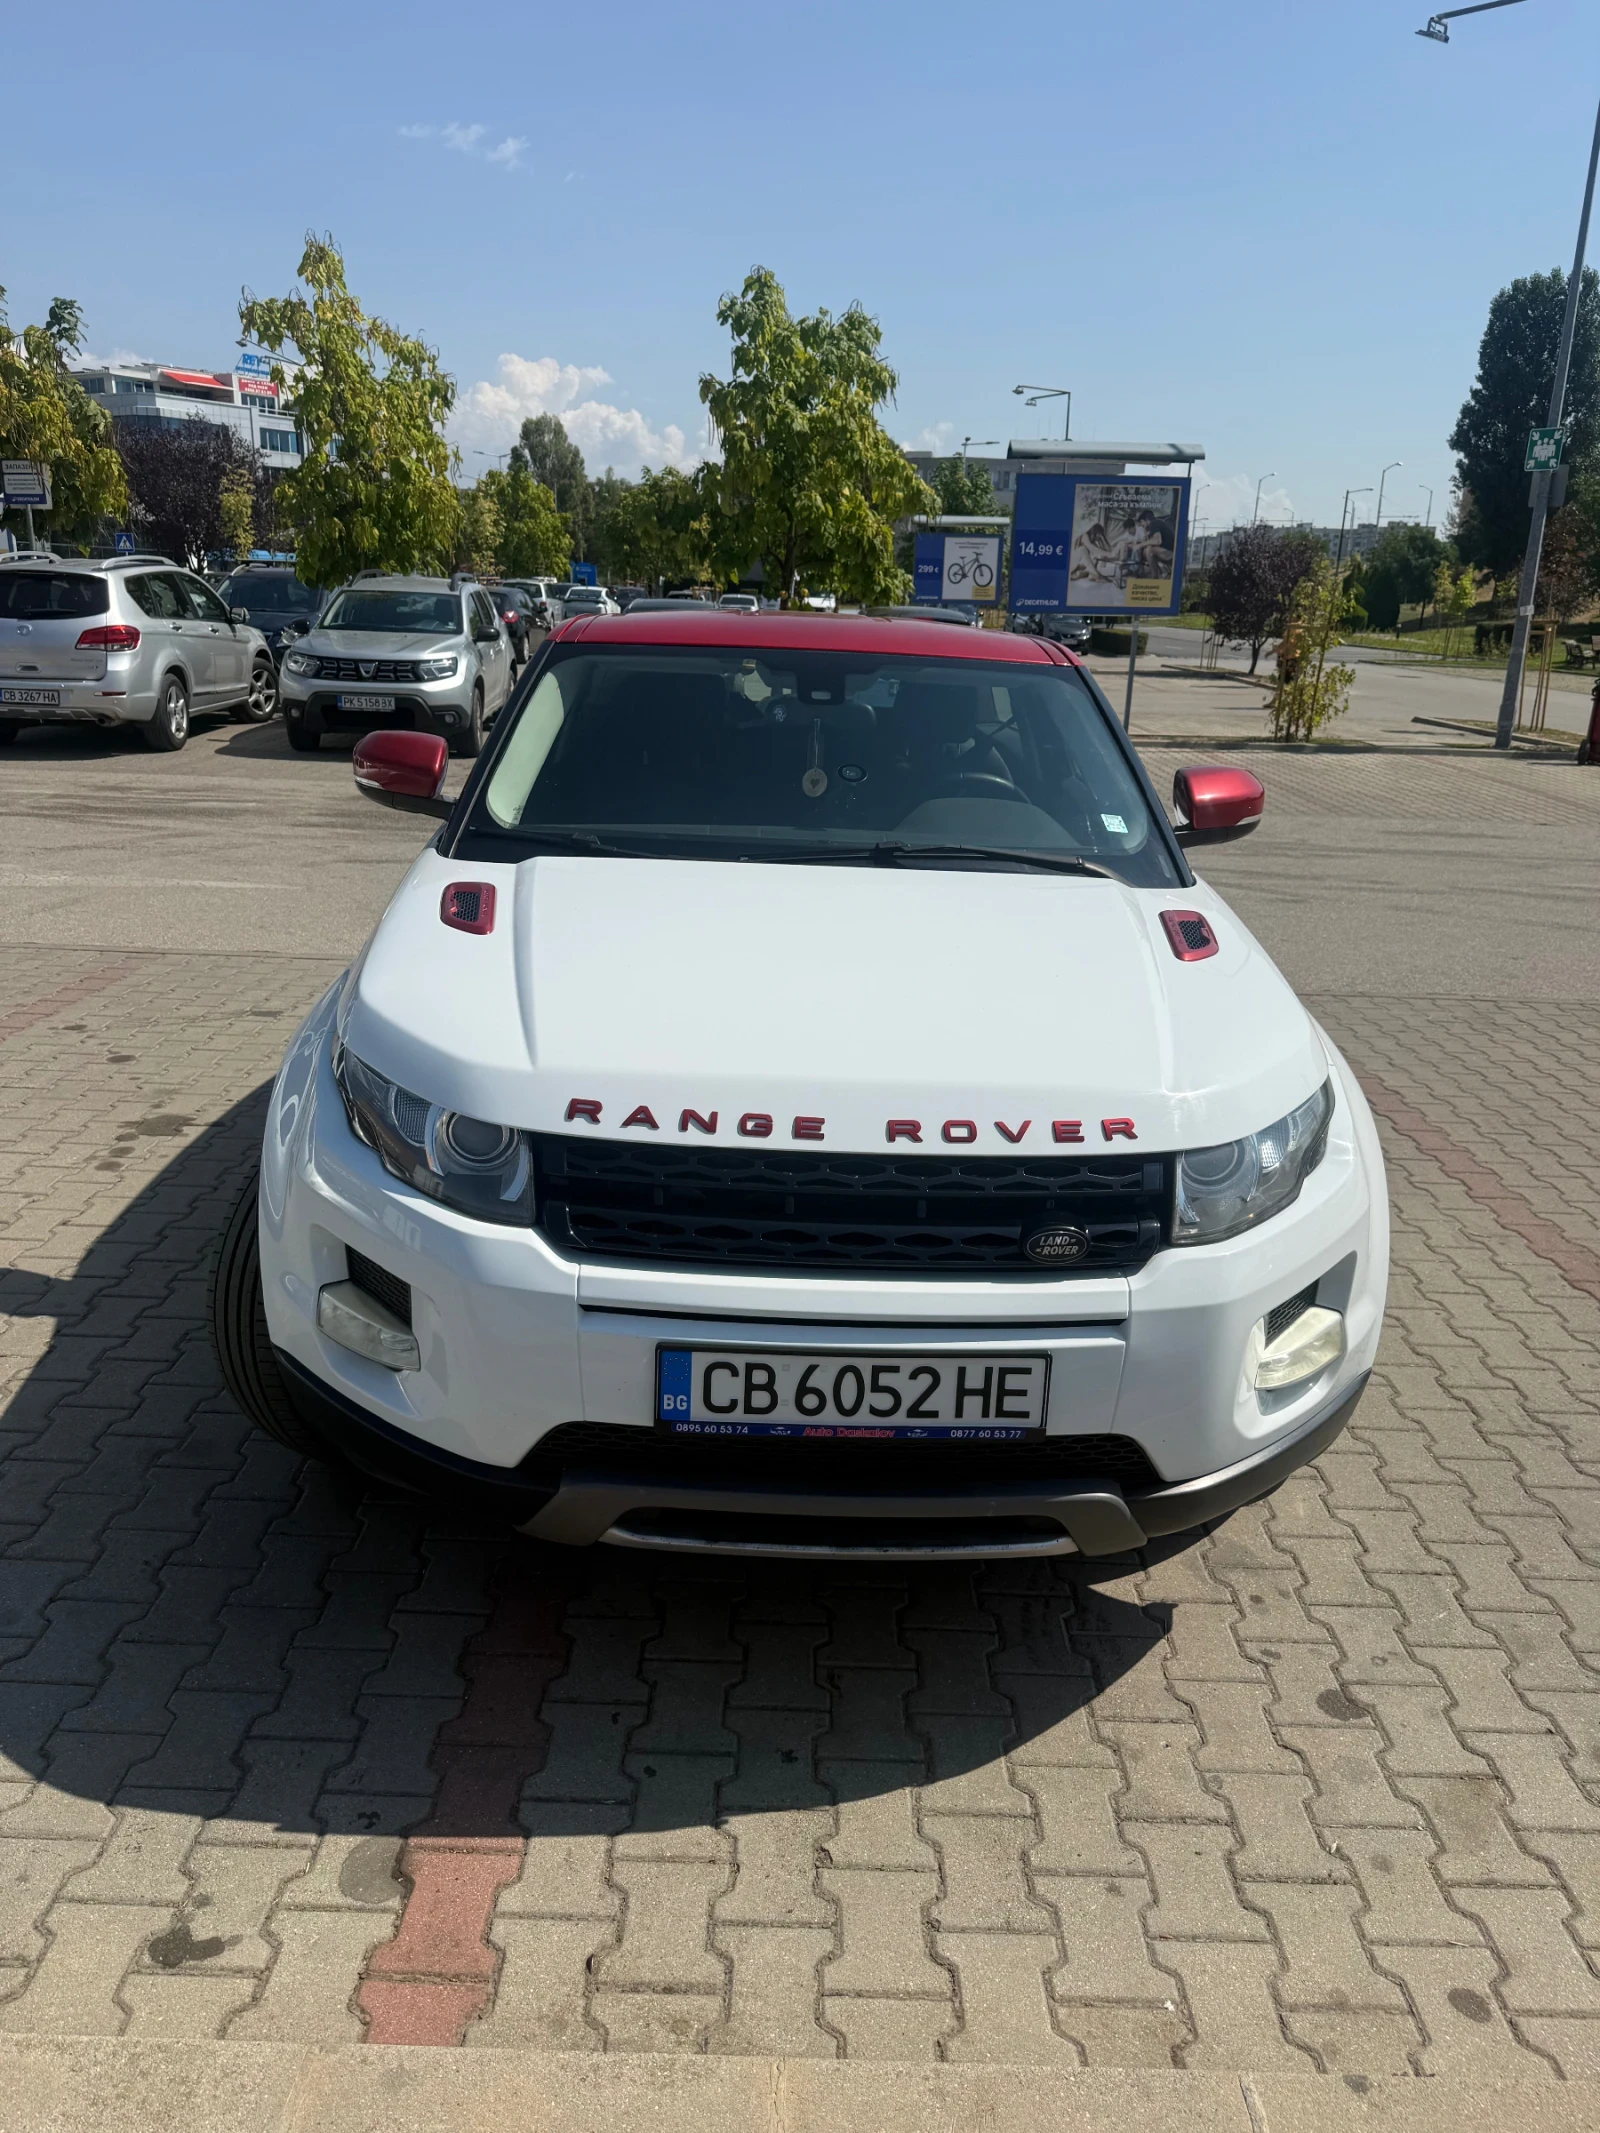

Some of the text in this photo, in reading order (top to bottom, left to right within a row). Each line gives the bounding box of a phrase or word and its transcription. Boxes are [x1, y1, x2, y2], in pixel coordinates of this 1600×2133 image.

[1019, 541, 1063, 557] 14,99 €
[918, 565, 934, 573] 299
[18, 691, 41, 702] 3267
[43, 692, 57, 703] HA
[357, 697, 380, 708] 5158
[564, 1098, 1139, 1144] RANGE ROVER
[1040, 1236, 1070, 1246] LAND
[1042, 1245, 1079, 1255] ROVER
[703, 1361, 1033, 1419] CB 6052 HE
[663, 1394, 688, 1410] BG
[676, 1423, 749, 1434] 0895 60 53 74
[803, 1426, 896, 1437] Auto Daskalov
[950, 1429, 1021, 1438] 0877 60 53 77
